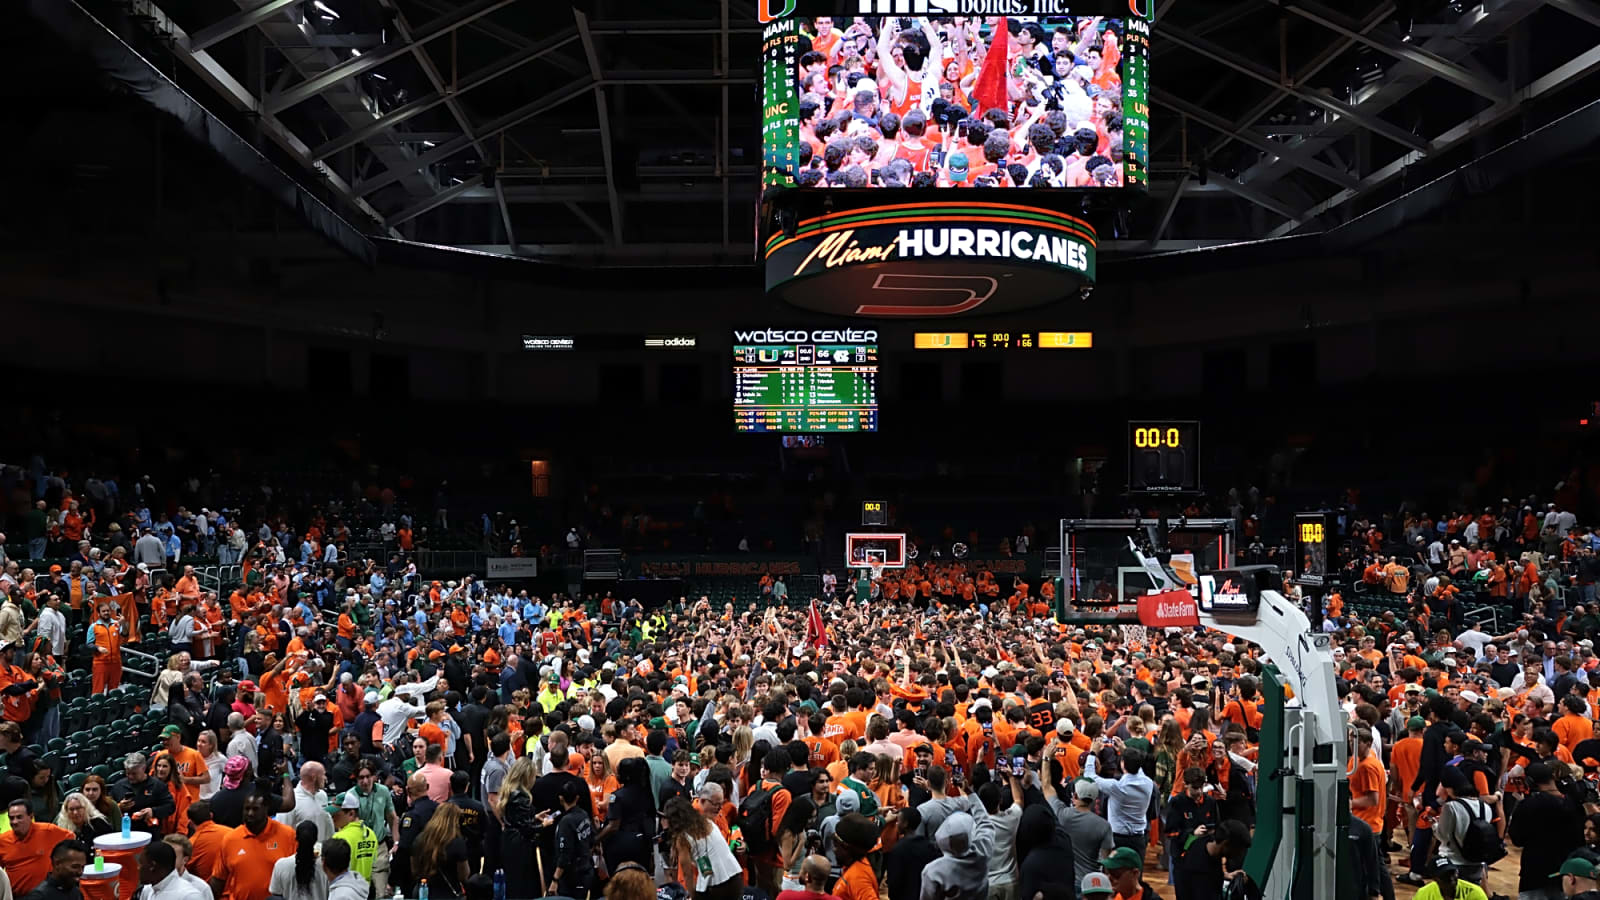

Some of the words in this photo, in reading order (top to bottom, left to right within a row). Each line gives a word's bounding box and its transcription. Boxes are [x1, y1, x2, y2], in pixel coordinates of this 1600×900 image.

[784, 36, 798, 44] PTS
[766, 103, 788, 118] UNC
[794, 230, 899, 276] Miami
[898, 228, 1087, 271] HURRICANES
[665, 338, 696, 346] adidas
[977, 339, 986, 348] 75
[1136, 428, 1179, 448] 00.0
[1031, 710, 1053, 727] 33
[358, 841, 375, 849] BEST
